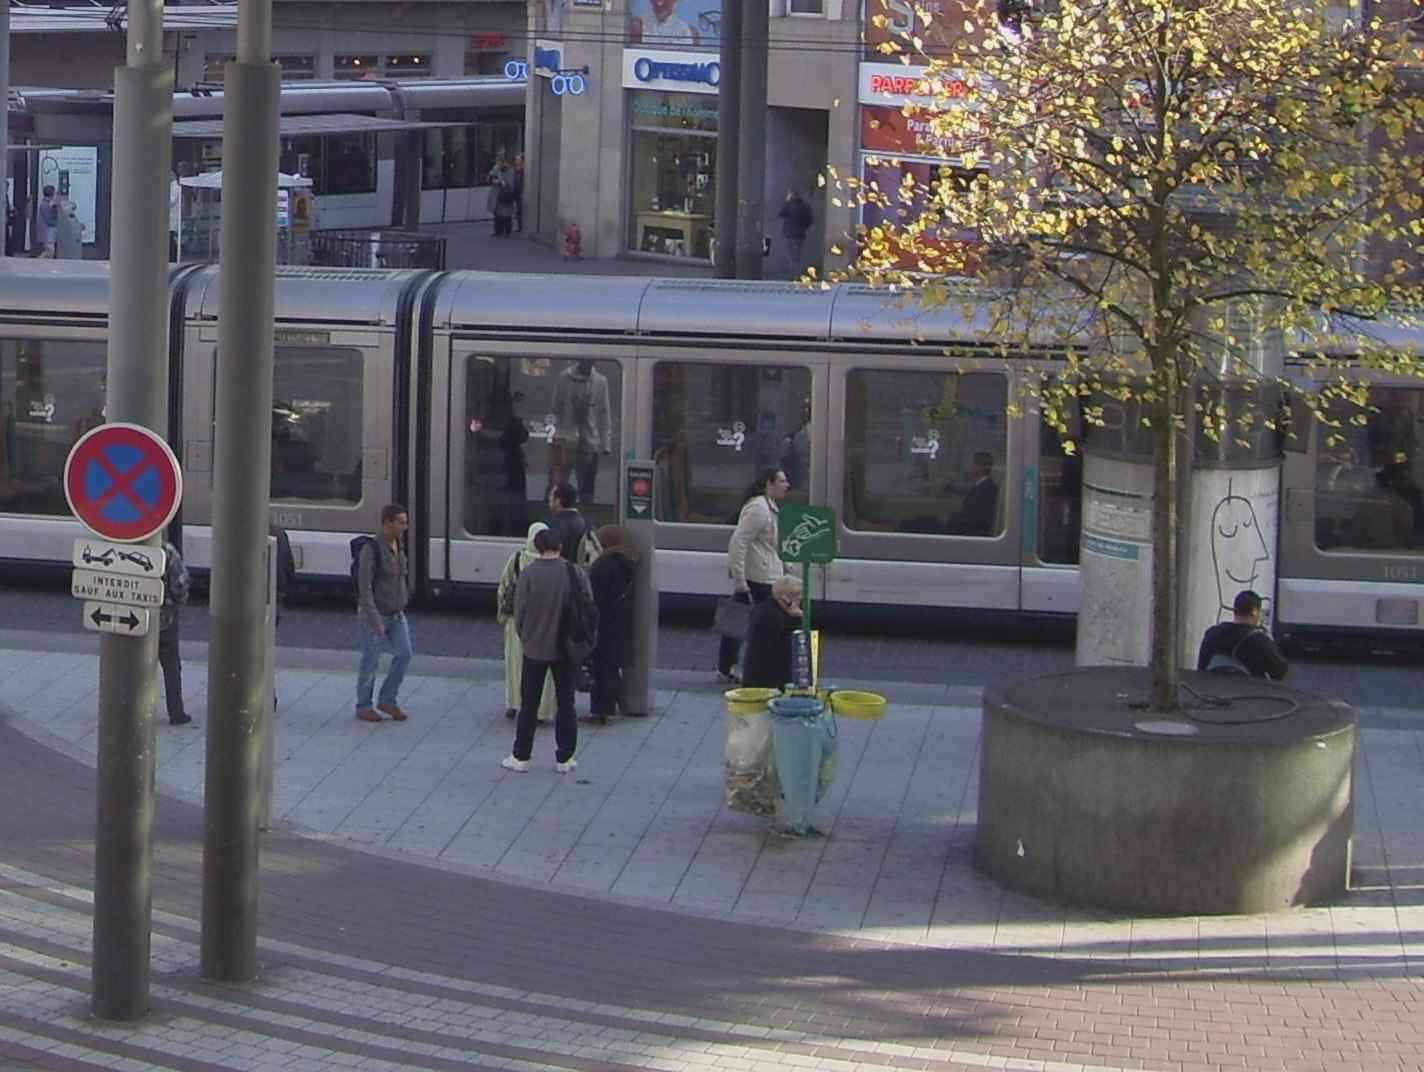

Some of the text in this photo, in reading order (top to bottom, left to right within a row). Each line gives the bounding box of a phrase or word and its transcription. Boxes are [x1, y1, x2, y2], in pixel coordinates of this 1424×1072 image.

[92, 576, 139, 590] INTERDIT
[74, 584, 160, 603] SAUF AUX TAXIS
